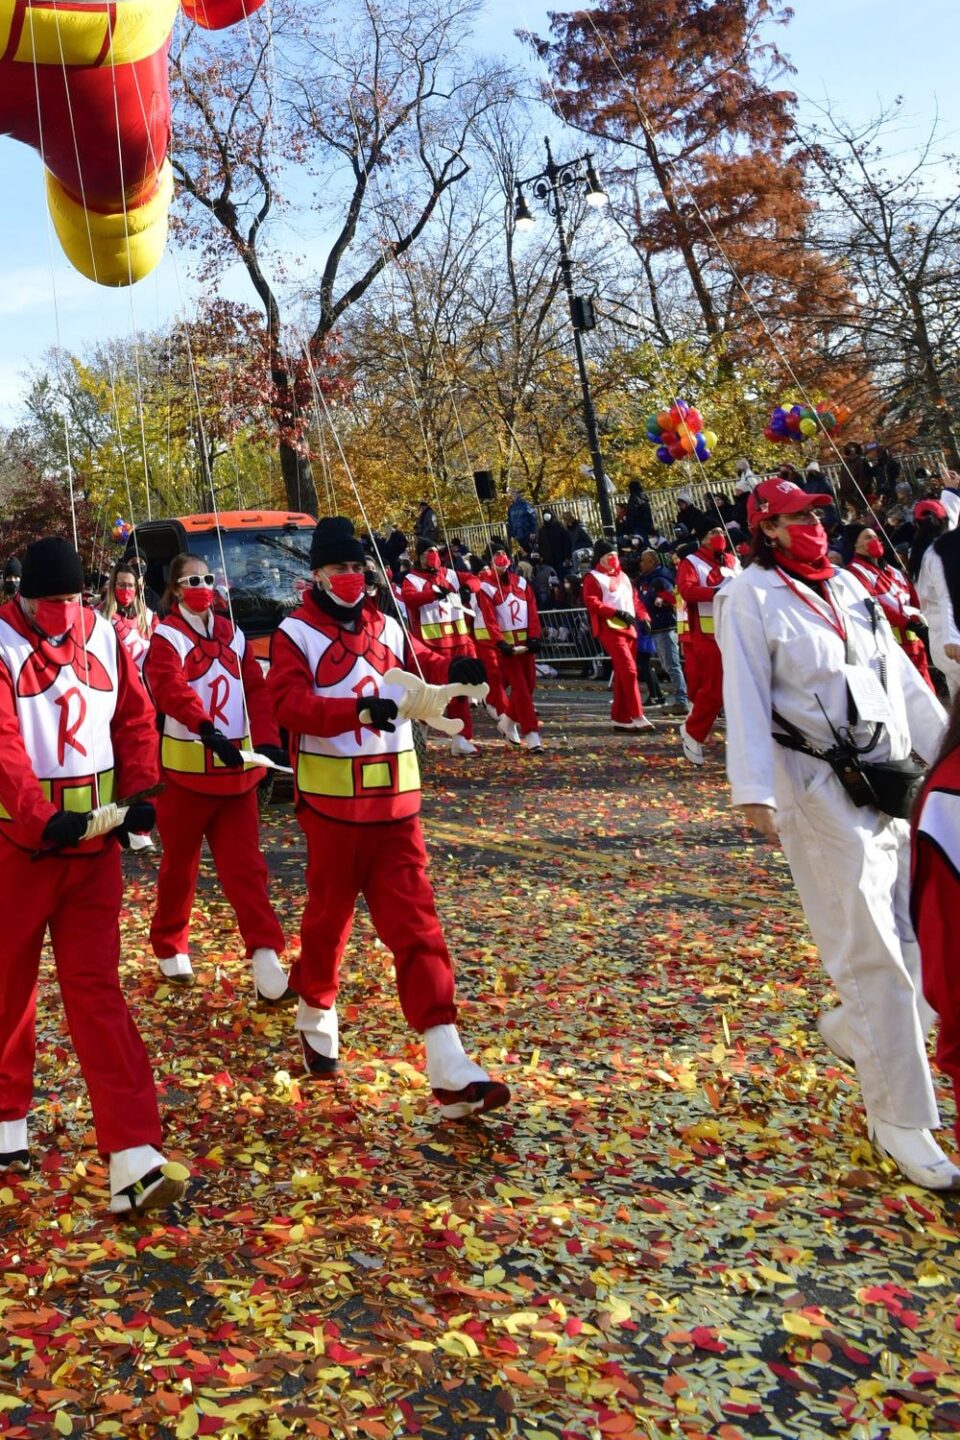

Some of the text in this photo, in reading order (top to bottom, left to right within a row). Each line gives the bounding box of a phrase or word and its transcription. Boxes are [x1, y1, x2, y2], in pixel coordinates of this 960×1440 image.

[508, 599, 522, 626] R
[208, 675, 230, 726] R
[54, 687, 87, 767] R
